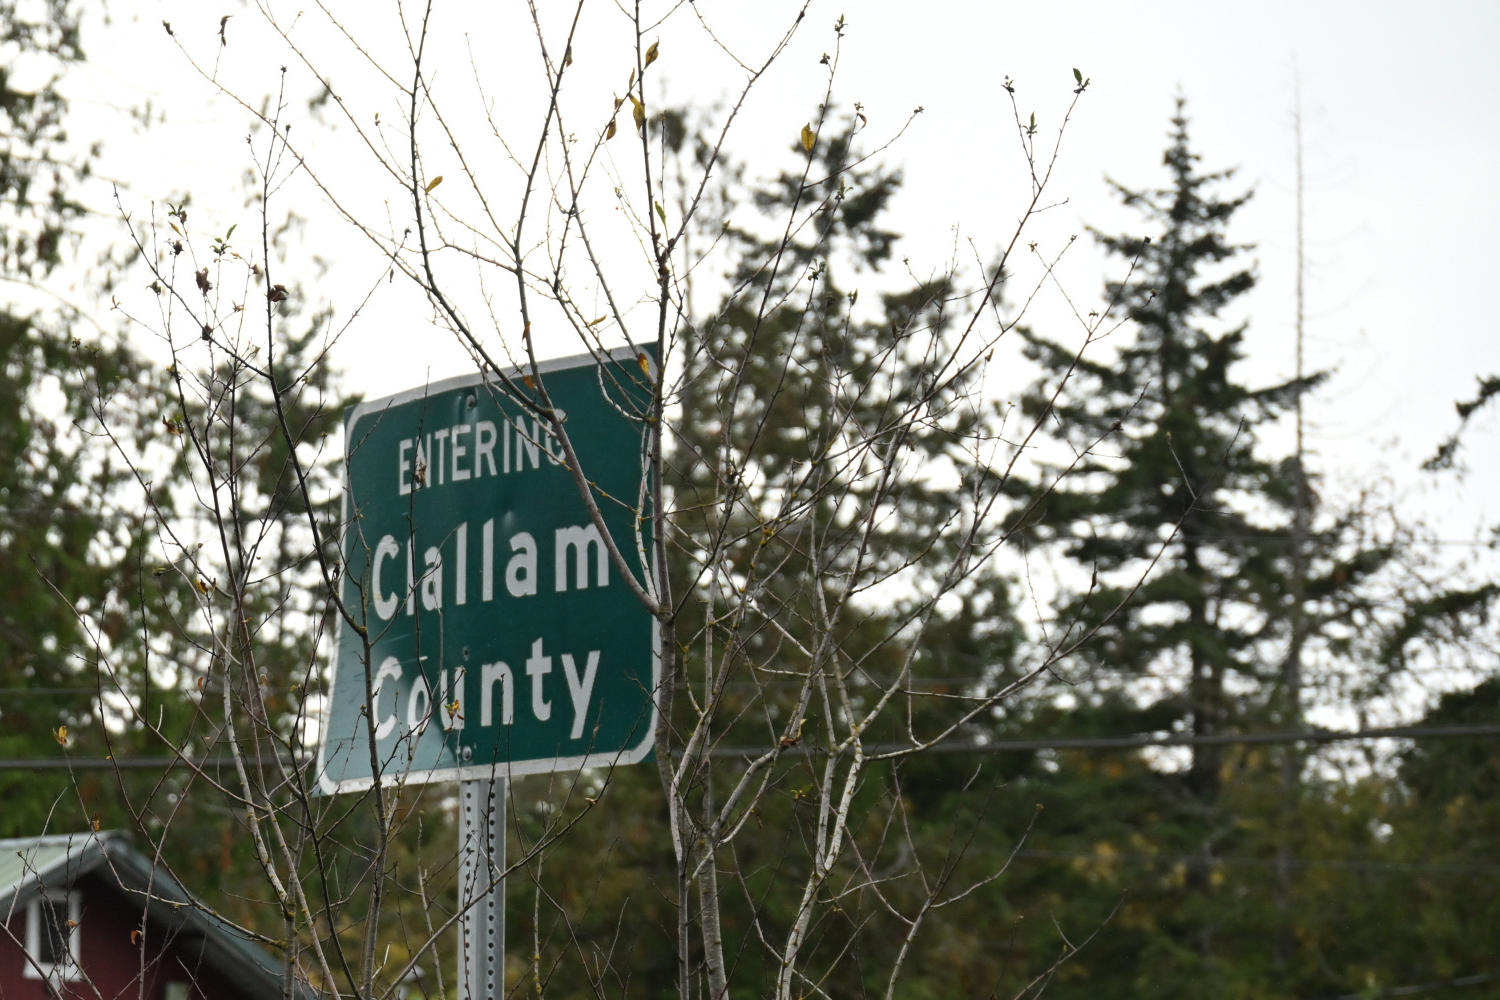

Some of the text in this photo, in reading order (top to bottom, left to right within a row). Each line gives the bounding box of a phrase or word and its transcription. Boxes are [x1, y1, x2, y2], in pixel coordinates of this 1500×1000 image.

[399, 408, 568, 495] ENTERING
[372, 518, 609, 620] Clallam
[372, 637, 601, 740] County
